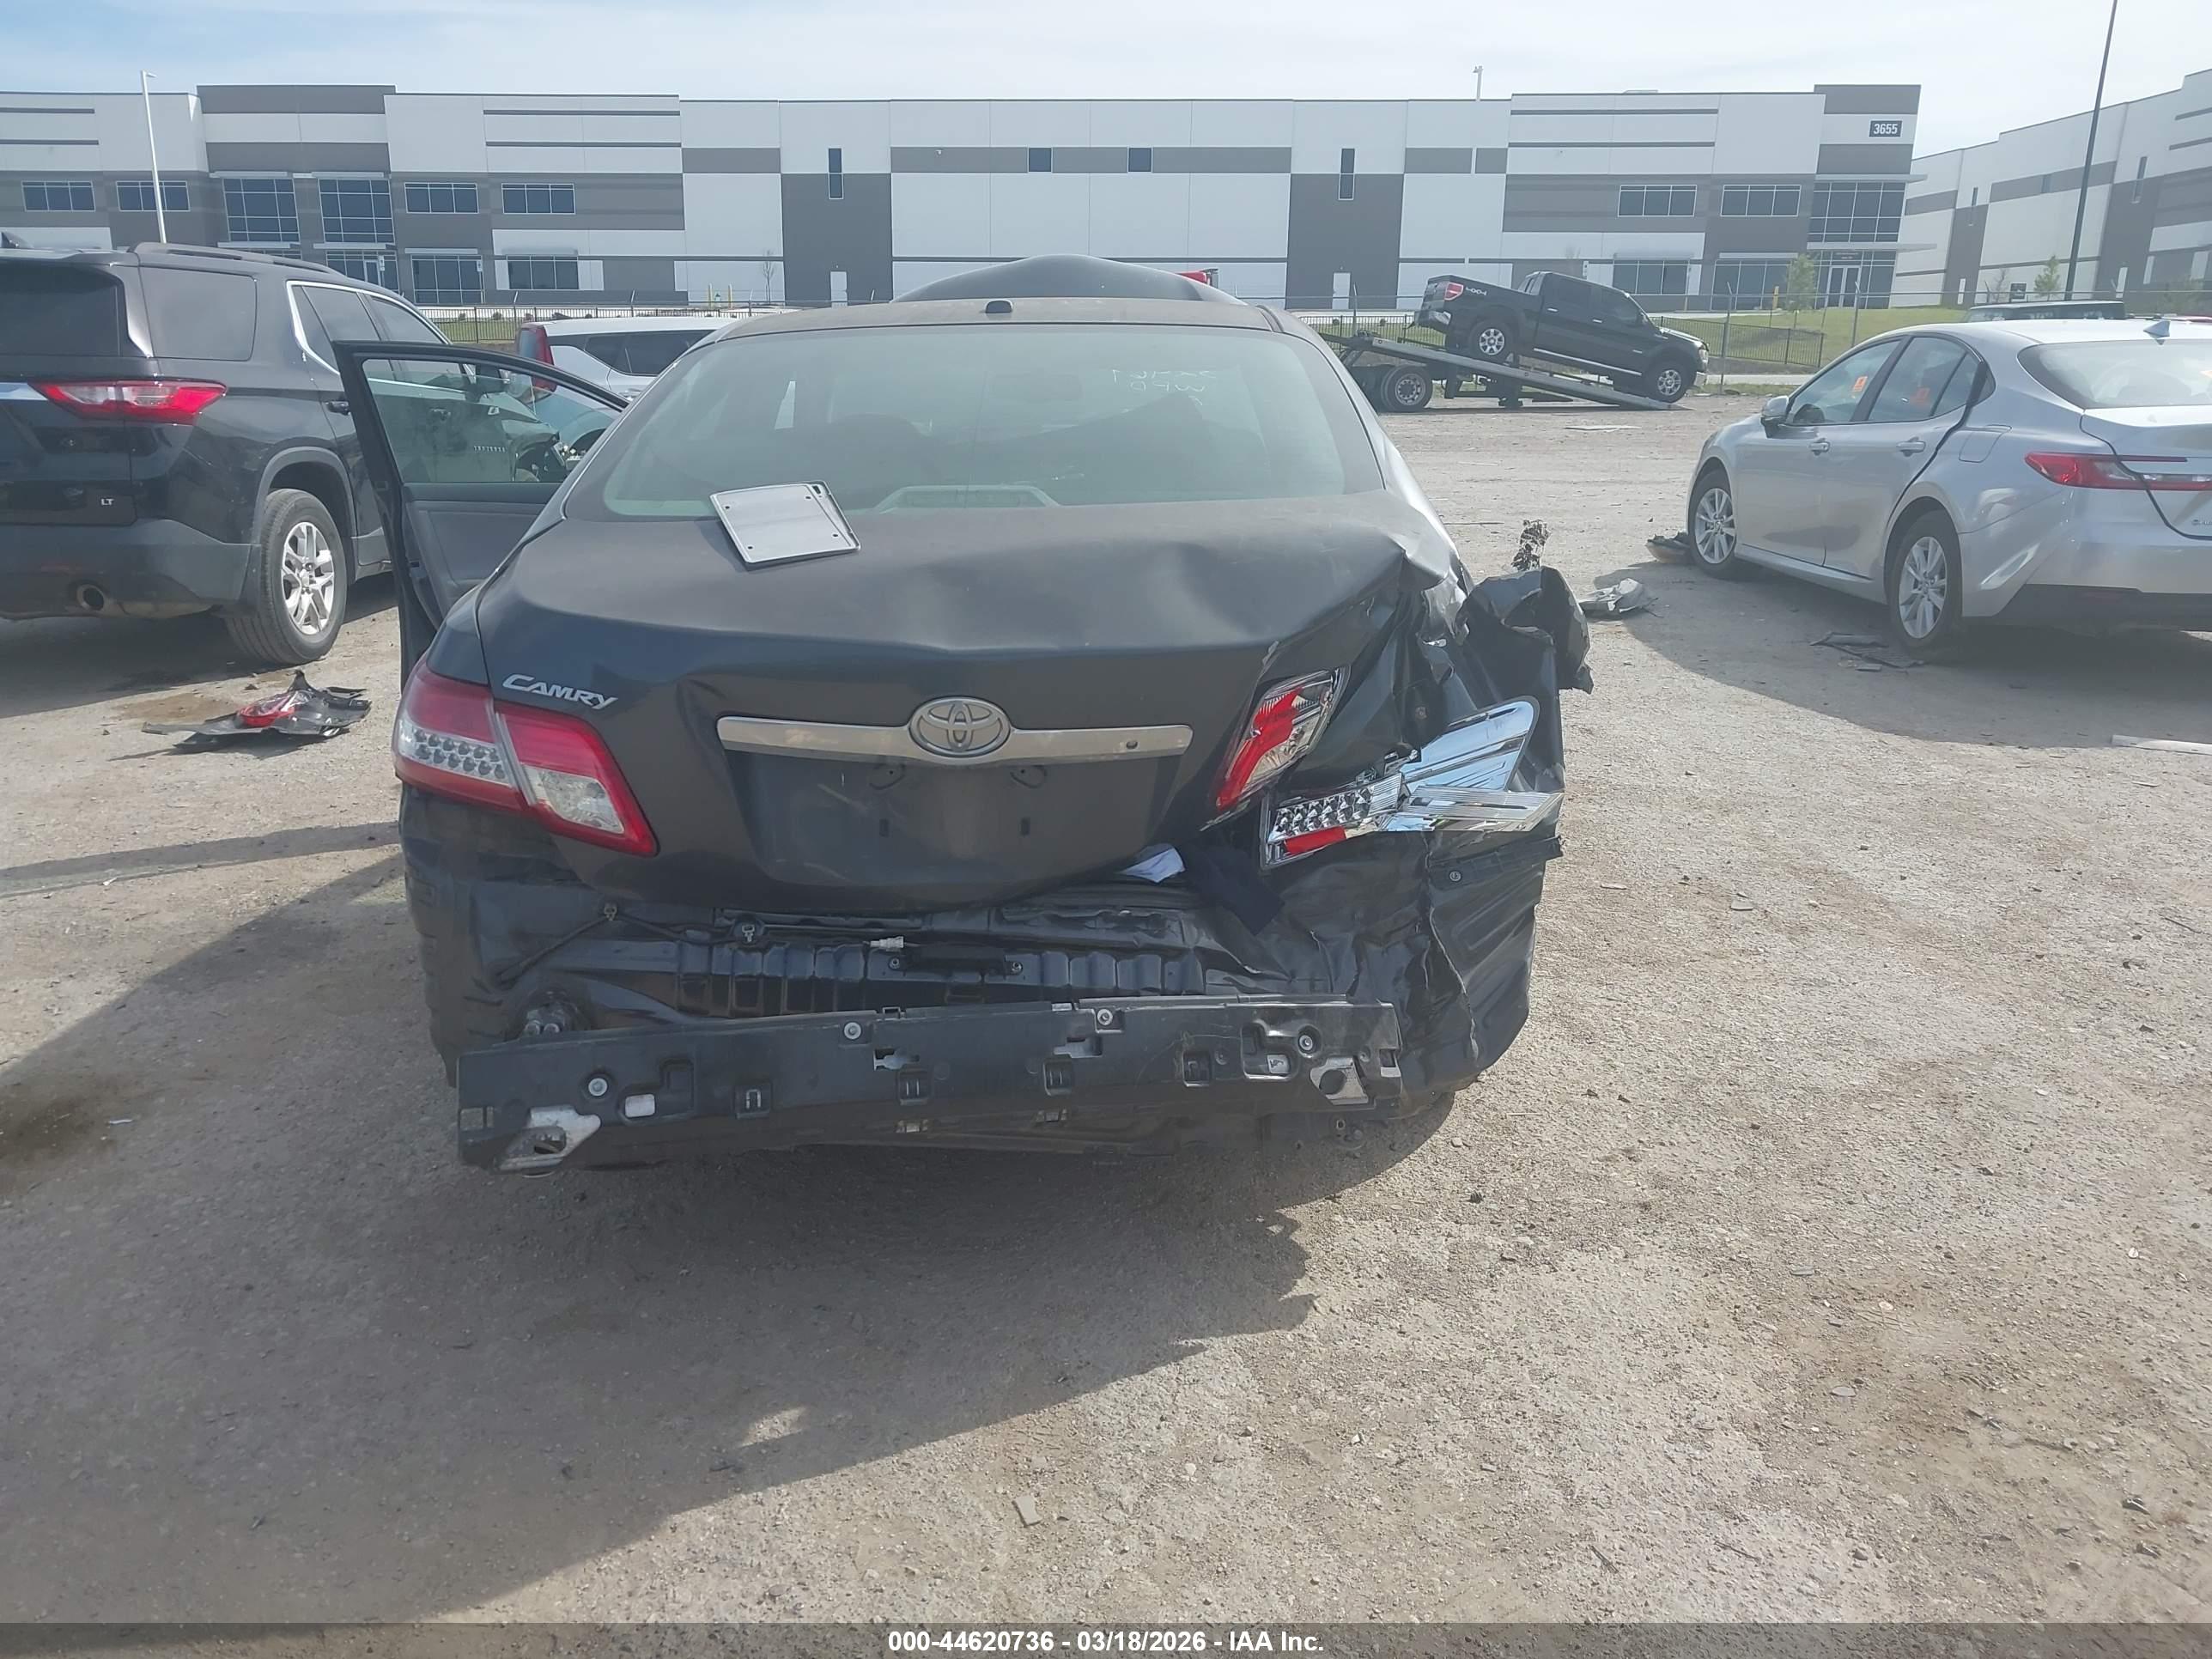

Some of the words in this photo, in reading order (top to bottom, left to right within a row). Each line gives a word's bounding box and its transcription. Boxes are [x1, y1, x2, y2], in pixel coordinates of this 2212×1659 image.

[1873, 123, 1899, 135] 3655
[100, 498, 115, 507] LT
[502, 673, 619, 710] CAMRY
